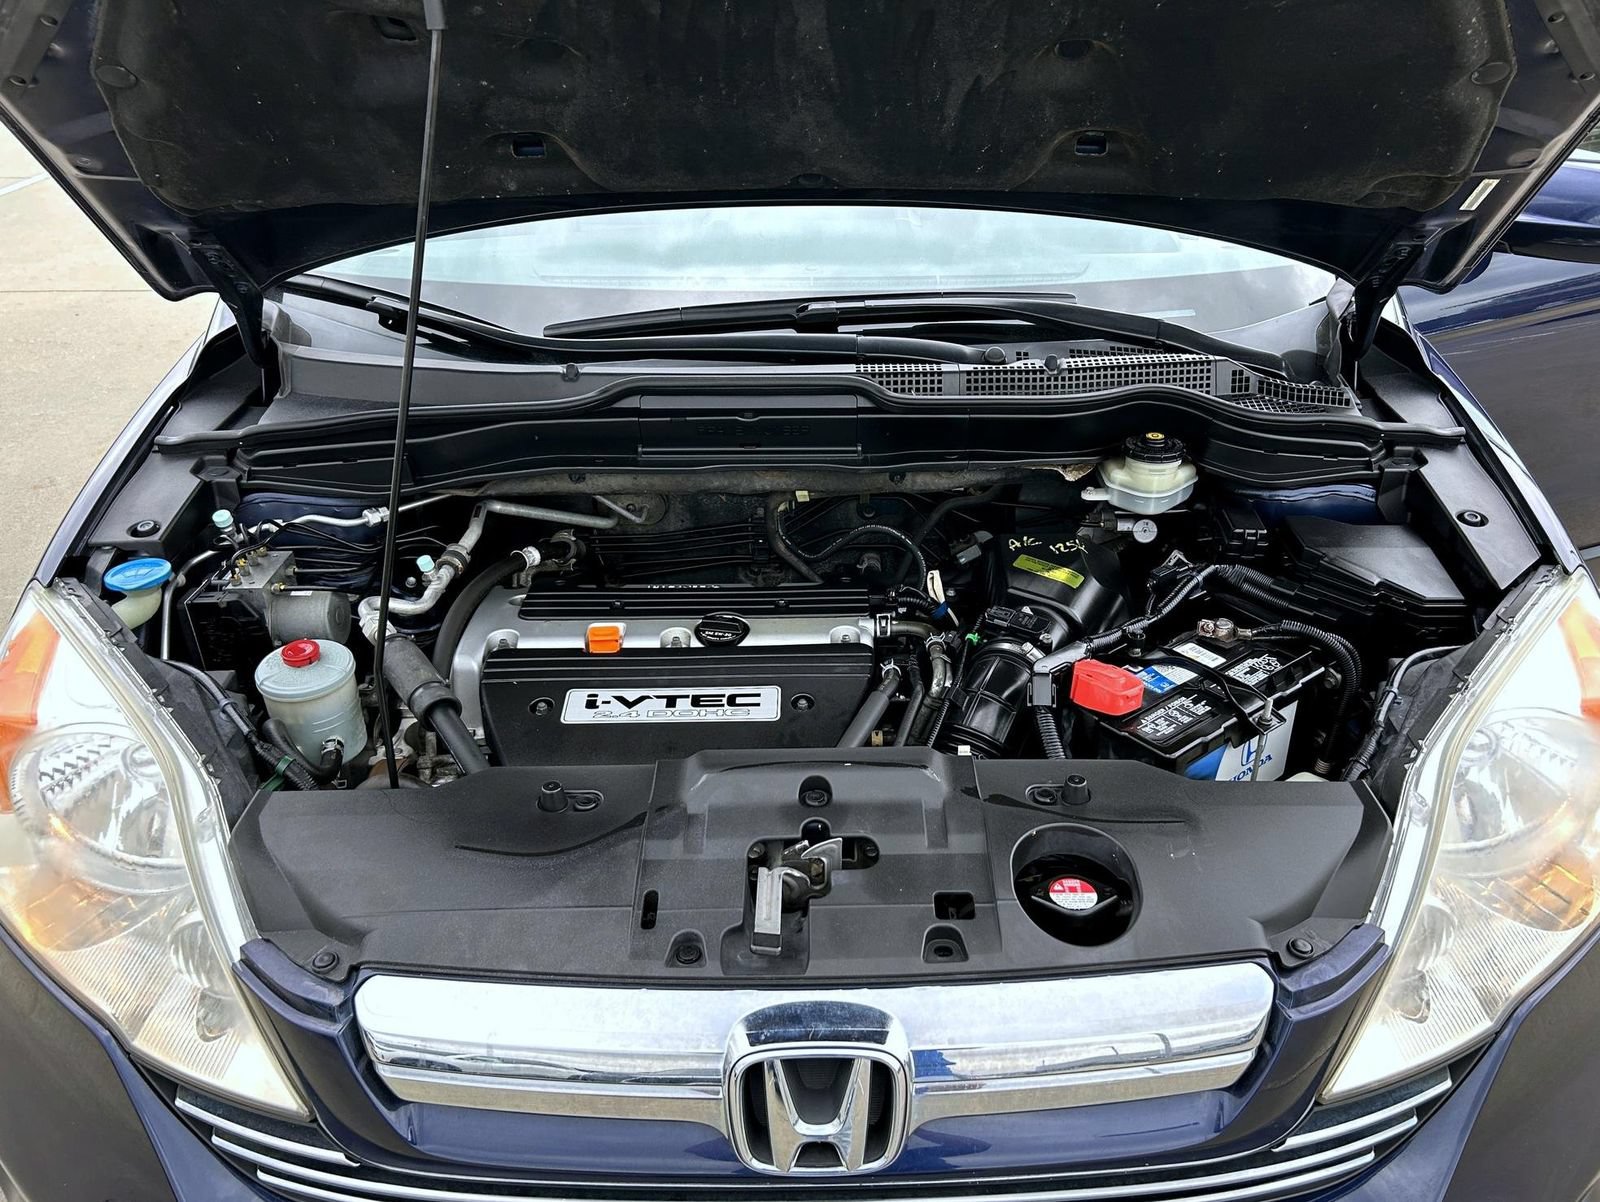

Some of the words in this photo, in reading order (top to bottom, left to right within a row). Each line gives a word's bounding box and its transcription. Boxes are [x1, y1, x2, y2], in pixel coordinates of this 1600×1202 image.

[585, 692, 761, 710] i-VTEC
[593, 710, 640, 719] 2.4
[647, 708, 750, 718] DOHC
